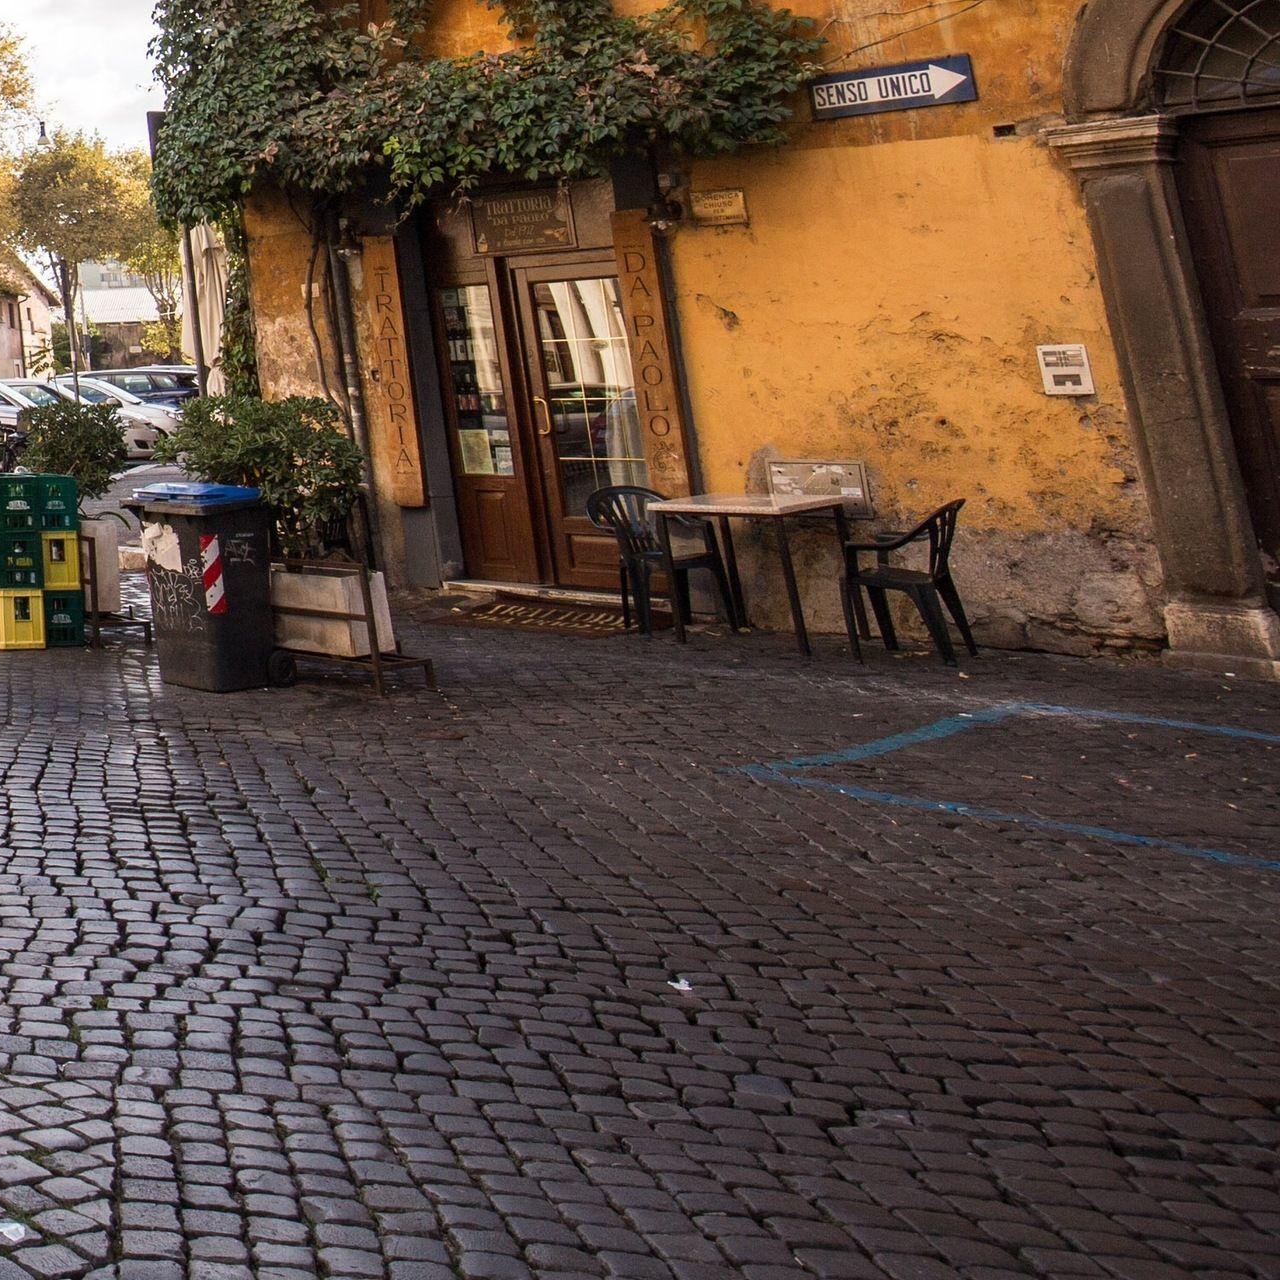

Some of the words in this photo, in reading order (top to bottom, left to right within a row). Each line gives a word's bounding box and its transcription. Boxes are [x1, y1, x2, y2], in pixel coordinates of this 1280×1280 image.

[815, 81, 869, 108] SENSO
[877, 72, 932, 99] UNICO
[703, 200, 733, 209] CHIUSO
[624, 251, 652, 297] DA
[374, 272, 414, 468] TRATTORIA
[633, 314, 671, 438] PAOLO
